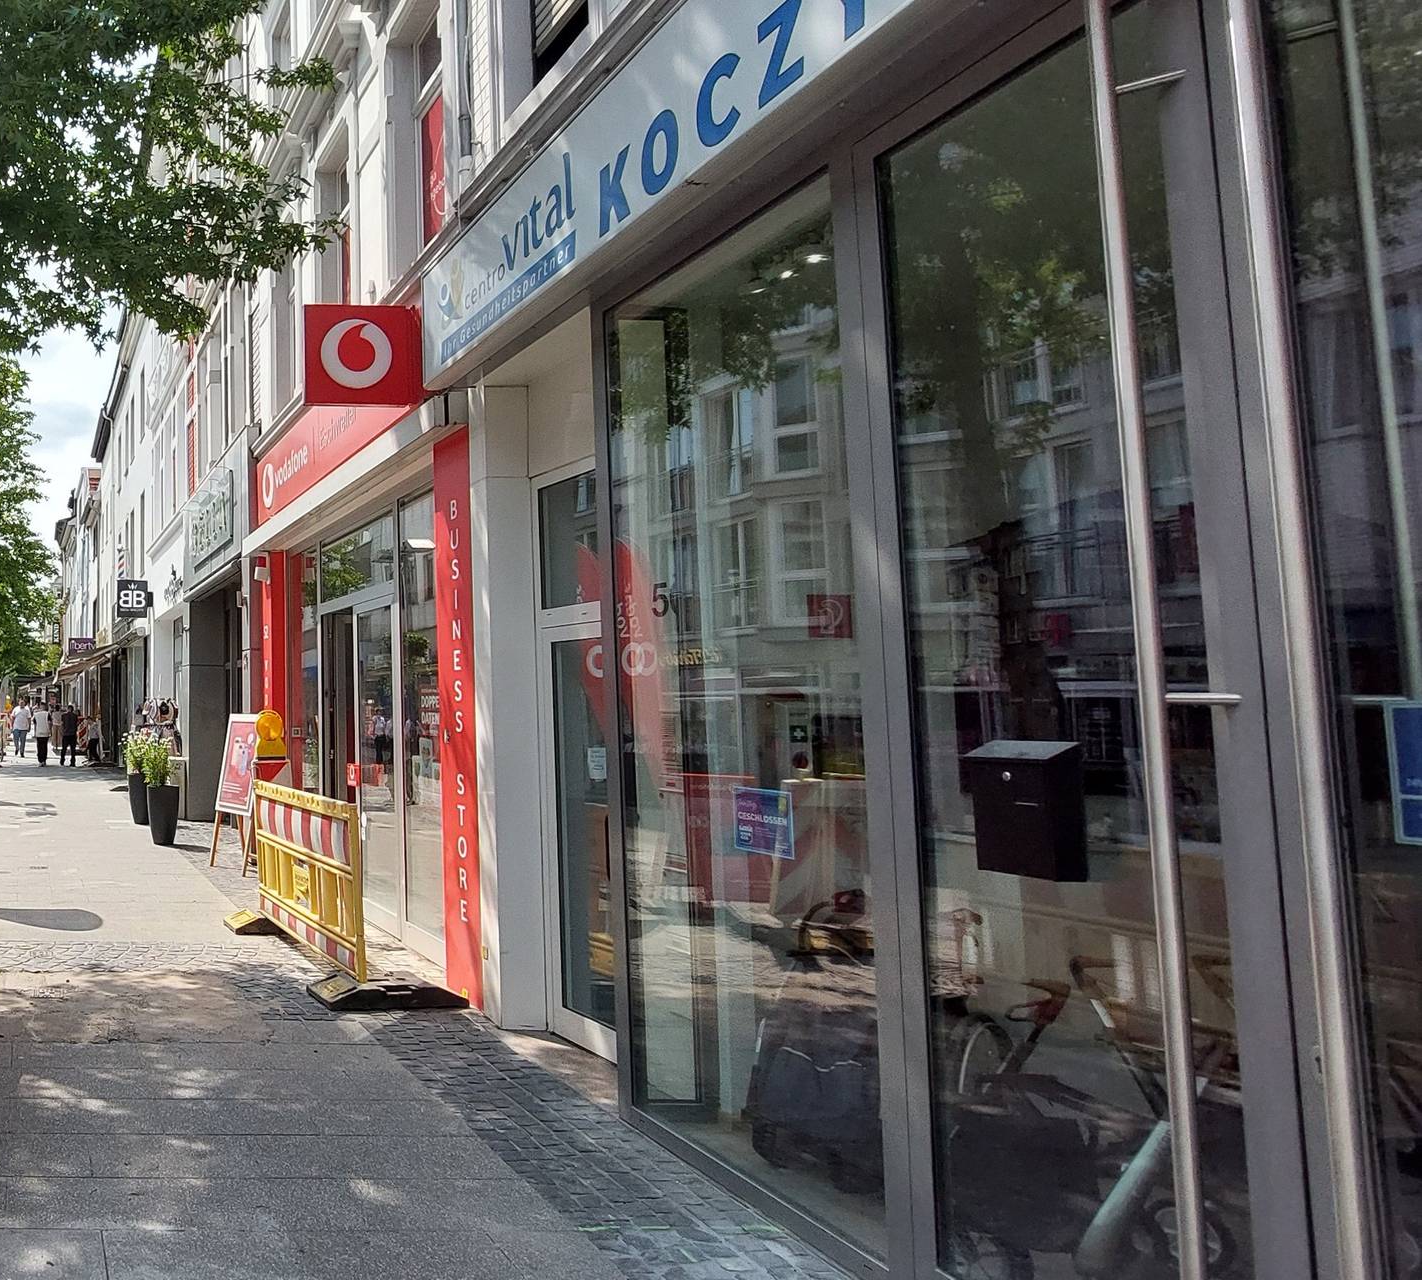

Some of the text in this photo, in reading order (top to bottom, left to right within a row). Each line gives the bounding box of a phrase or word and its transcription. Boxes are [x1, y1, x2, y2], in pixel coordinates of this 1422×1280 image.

[460, 243, 571, 344] Gesundheitspartner
[274, 444, 309, 489] vodafone
[449, 500, 464, 734] BUSINESS
[652, 582, 669, 617] 5
[456, 773, 469, 923] STORE
